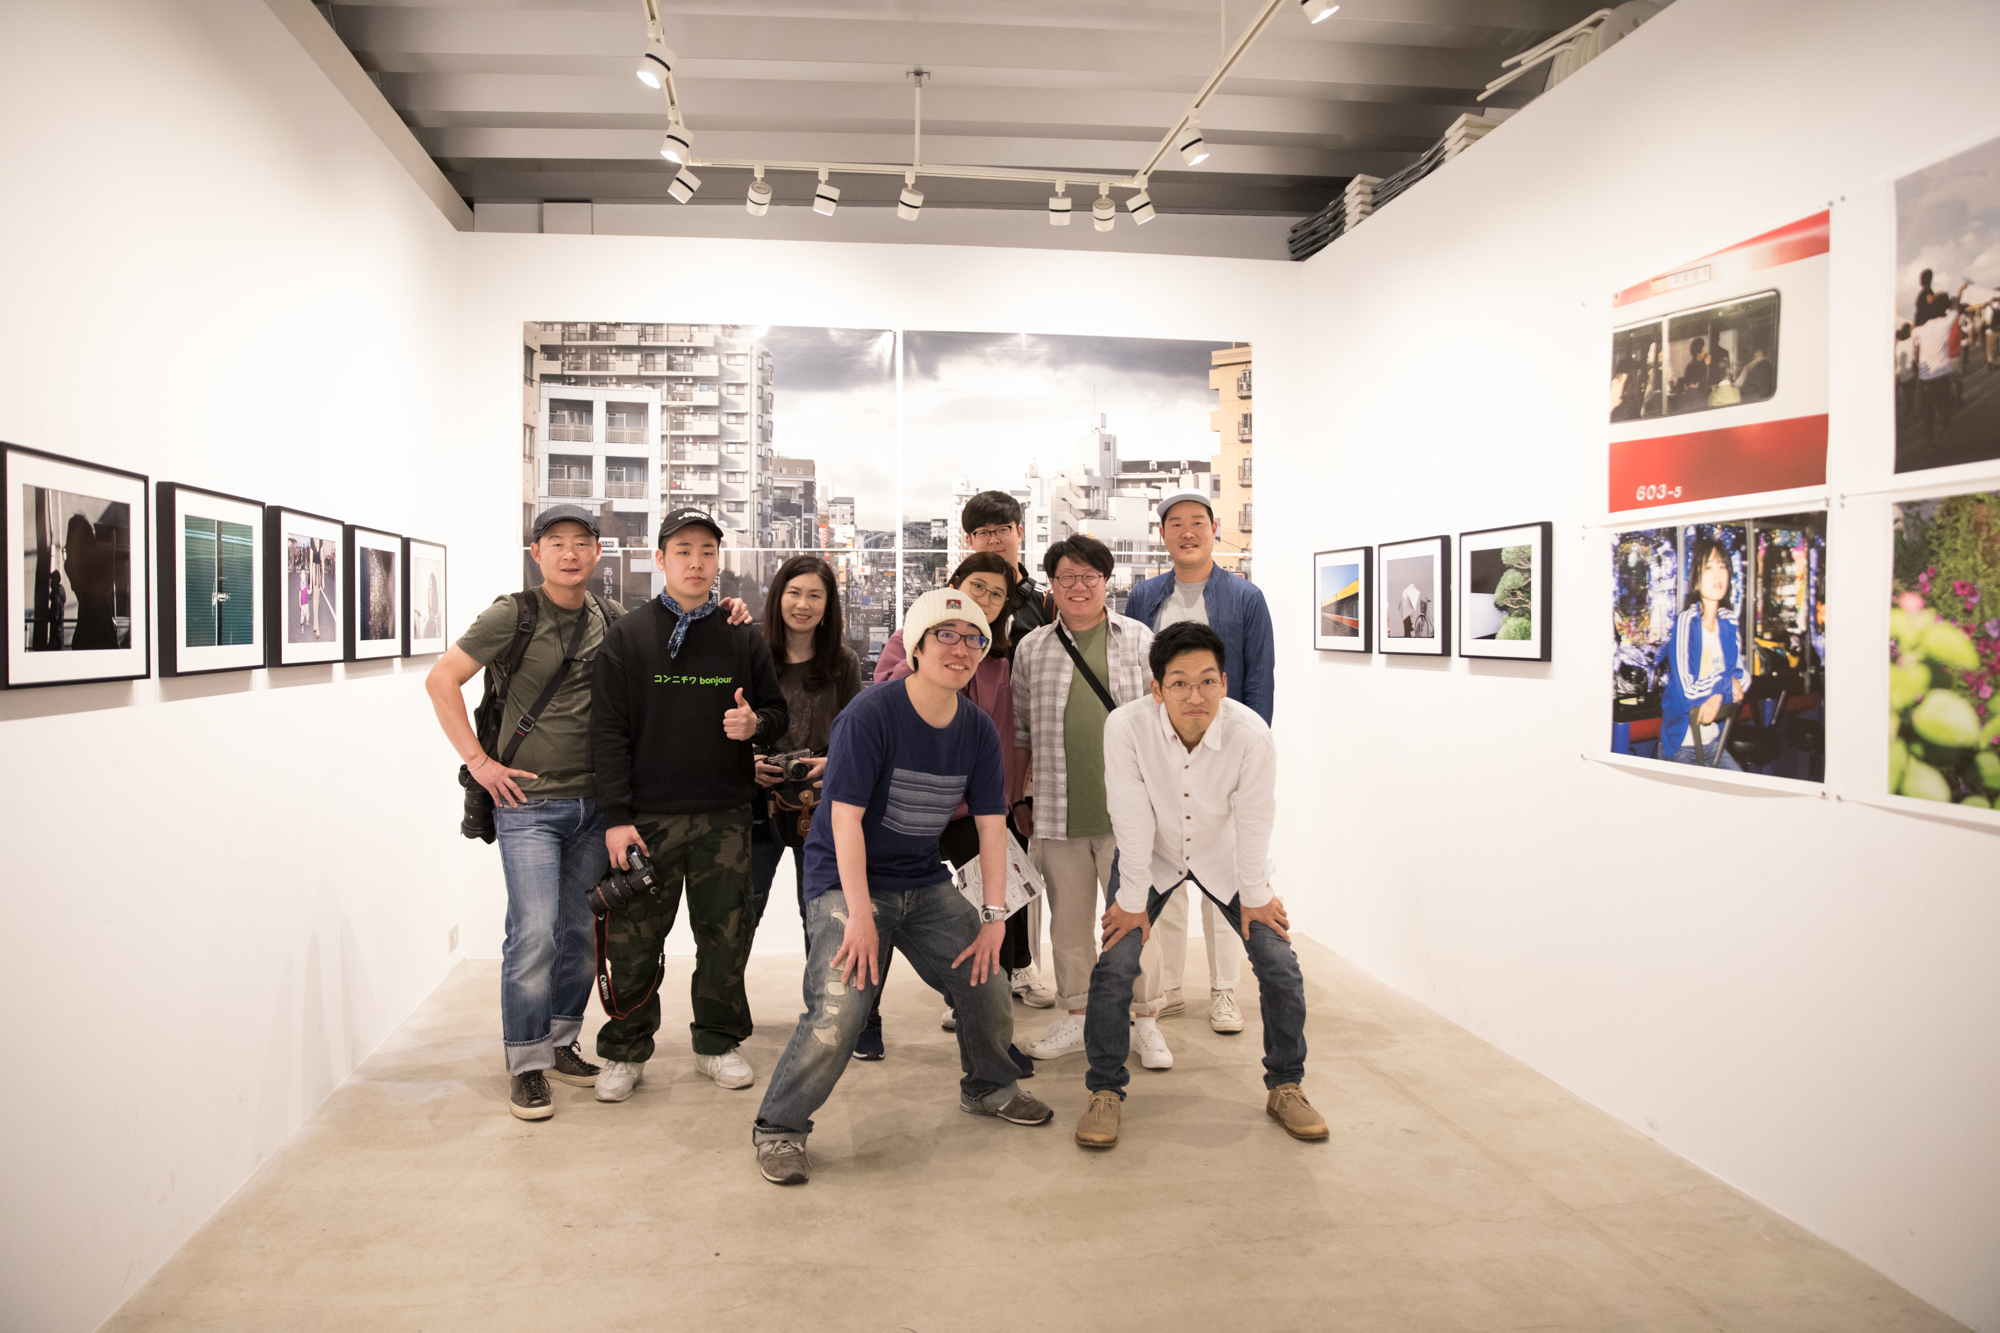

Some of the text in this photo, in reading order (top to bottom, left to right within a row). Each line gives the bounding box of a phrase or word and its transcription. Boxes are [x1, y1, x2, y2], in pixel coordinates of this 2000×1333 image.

[1636, 484, 1682, 501] 603-5
[654, 674, 733, 687] コンニチワ bonjour
[600, 974, 609, 1000] Canon
